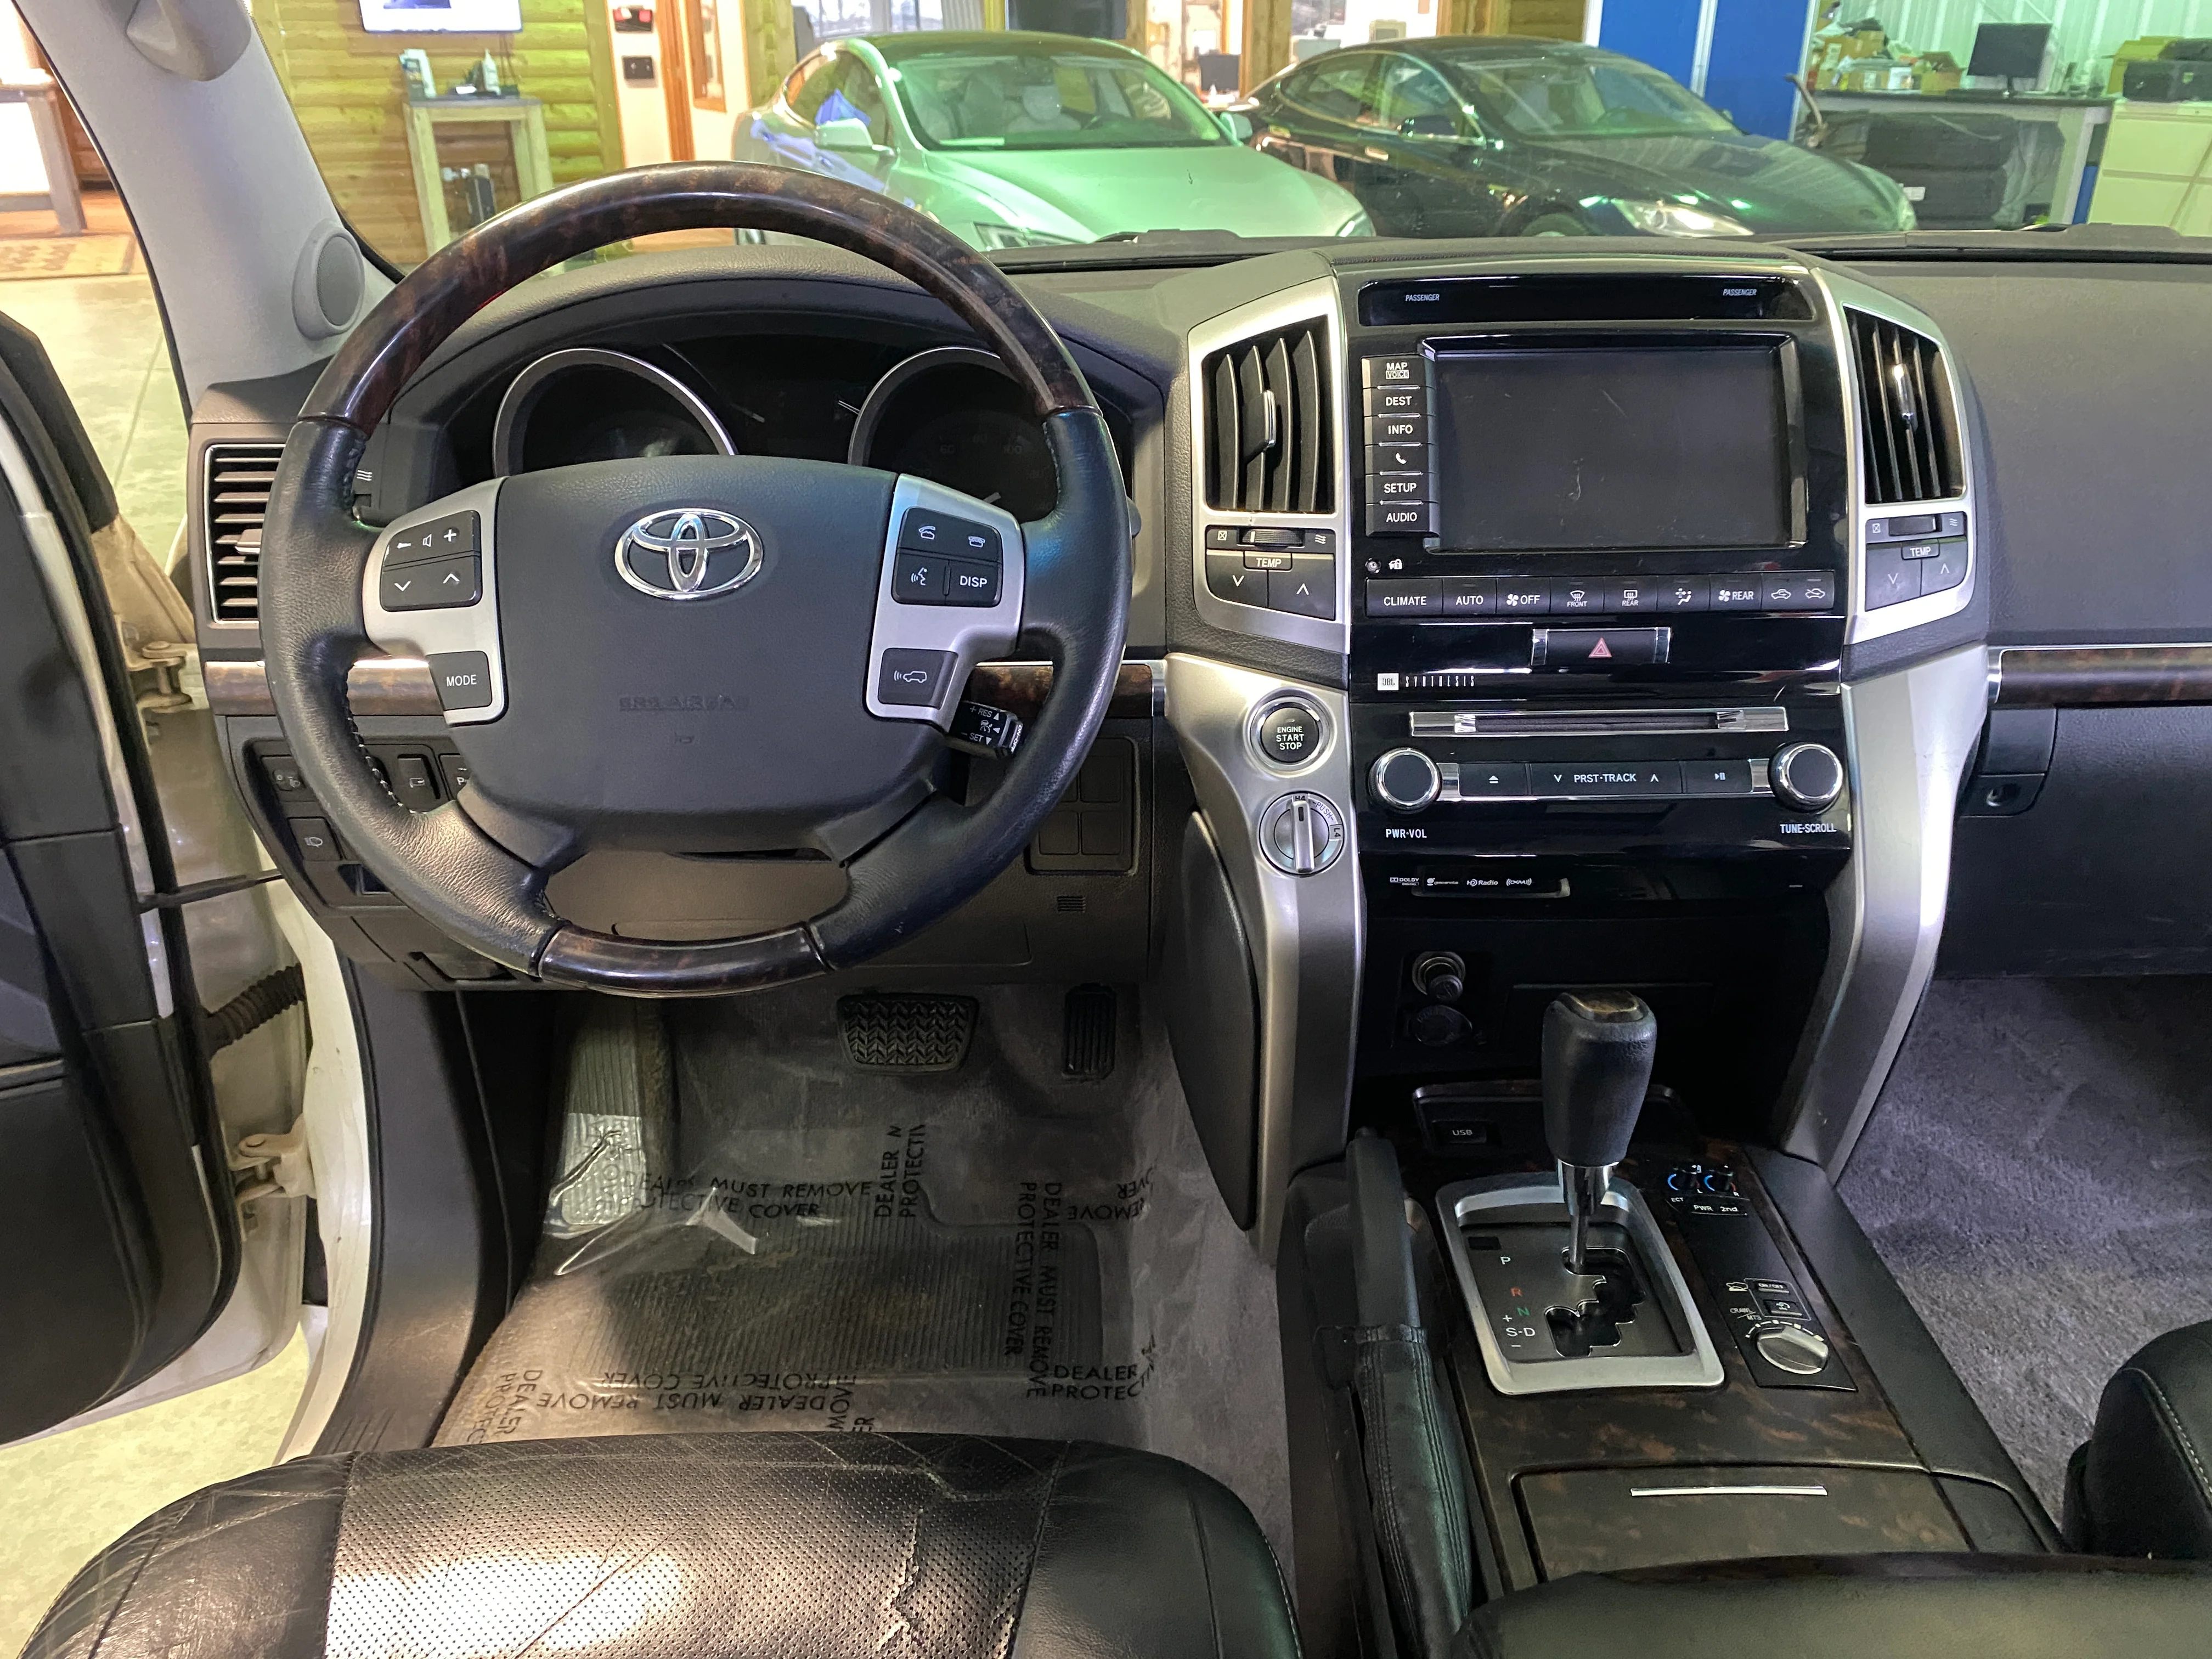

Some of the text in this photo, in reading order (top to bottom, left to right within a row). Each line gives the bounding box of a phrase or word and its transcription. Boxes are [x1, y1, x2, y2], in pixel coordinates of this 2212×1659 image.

[1405, 293, 1440, 302] PASSENGER
[1723, 288, 1757, 297] PASSENGER
[1386, 362, 1408, 371] MAP
[1385, 396, 1412, 407] DEST
[1387, 425, 1413, 435] INFO
[1384, 482, 1417, 494] SETUP
[1386, 512, 1418, 523] AUDIO
[1910, 546, 1931, 557] TEMP
[1256, 558, 1282, 568] TEMP
[959, 575, 988, 588] DISP
[1383, 595, 1427, 607] CLIMATE
[1455, 595, 1484, 606] AUTO
[1520, 594, 1541, 605] OFF
[1731, 590, 1754, 601] REAR
[445, 674, 477, 687] MODE
[1382, 675, 1475, 687] JBL SYNTHESIS
[978, 708, 993, 718] RES
[969, 733, 984, 743] SET
[1276, 733, 1305, 742] START
[1279, 742, 1302, 751] STOP
[1334, 827, 1341, 838] L4
[711, 1176, 770, 1198] MUST
[783, 1181, 872, 1198] REMOVE
[874, 1150, 899, 1218] DEALER
[748, 1203, 820, 1218] COVER
[1500, 1256, 1510, 1265] P
[1004, 1182, 1037, 1356] PROTECTIVE COVER
[1026, 1182, 1063, 1399] DEALER MUST REMOVE
[1511, 1287, 1522, 1297] R
[1517, 1307, 1530, 1317] N
[1054, 1363, 1138, 1381] DEALER
[601, 1372, 681, 1391] COVER
[536, 1392, 826, 1412] DEALER MUST REMOVE
[826, 1374, 857, 1430] MOVE
